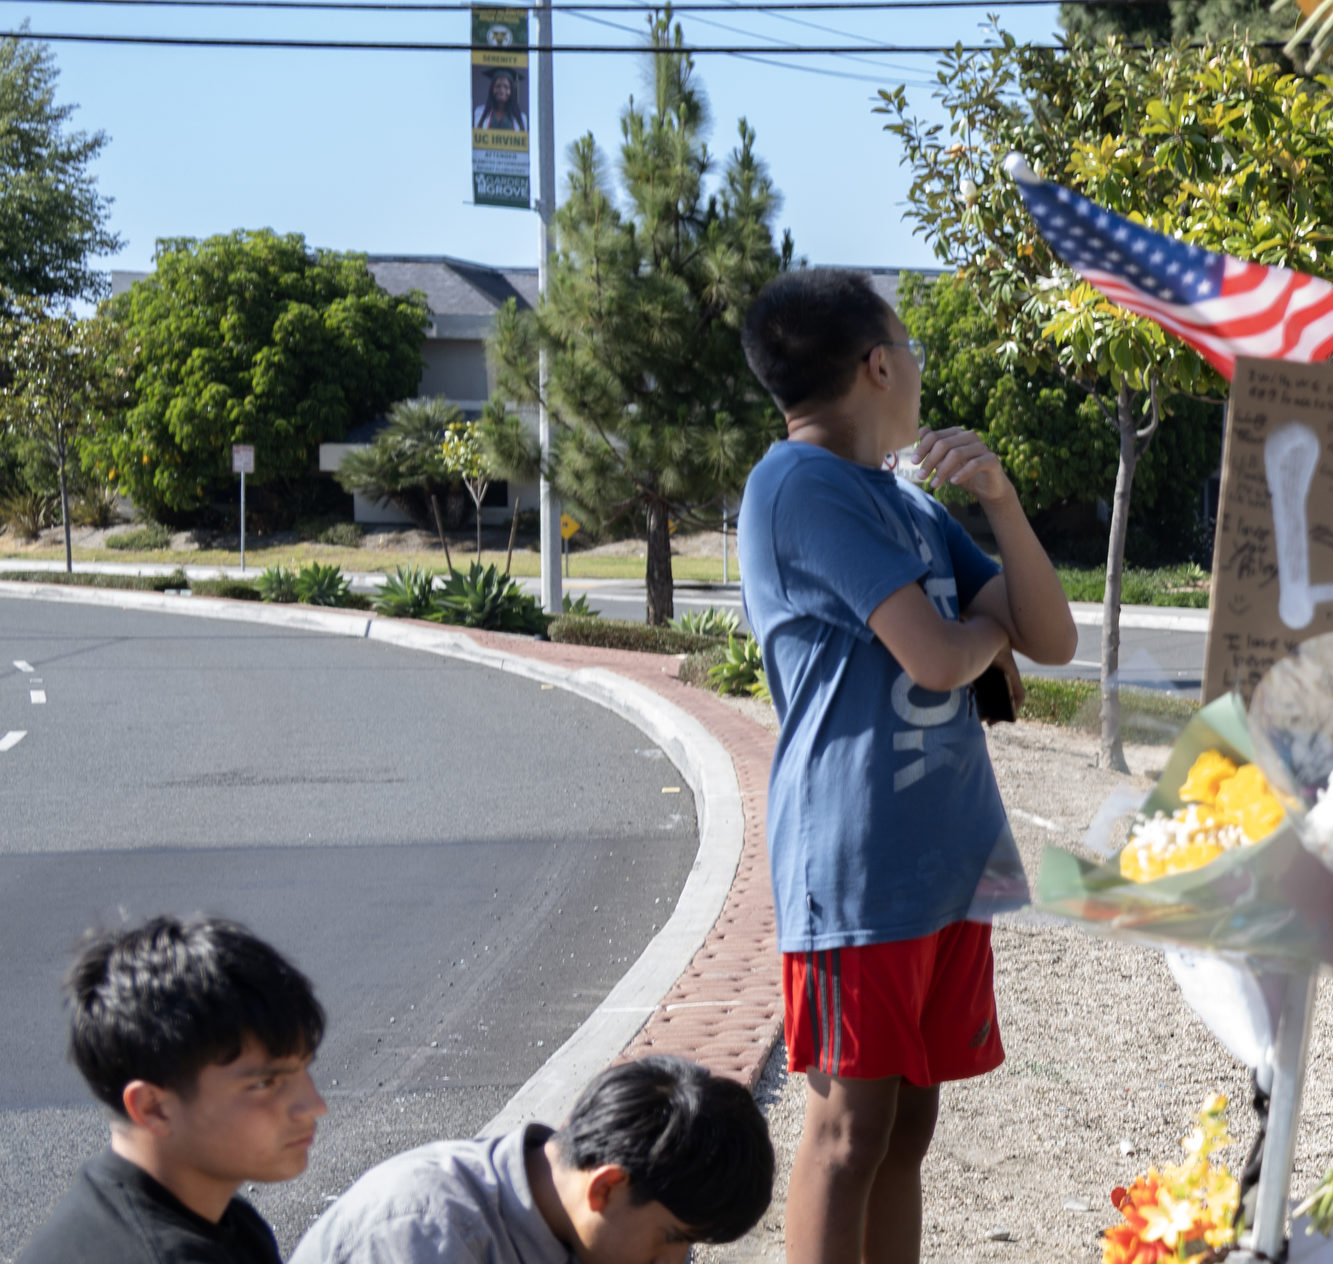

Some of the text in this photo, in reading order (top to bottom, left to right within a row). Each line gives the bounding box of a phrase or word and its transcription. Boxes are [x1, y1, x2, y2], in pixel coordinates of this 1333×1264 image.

[475, 134, 526, 146] UC IRVINE
[486, 183, 527, 197] GROVE
